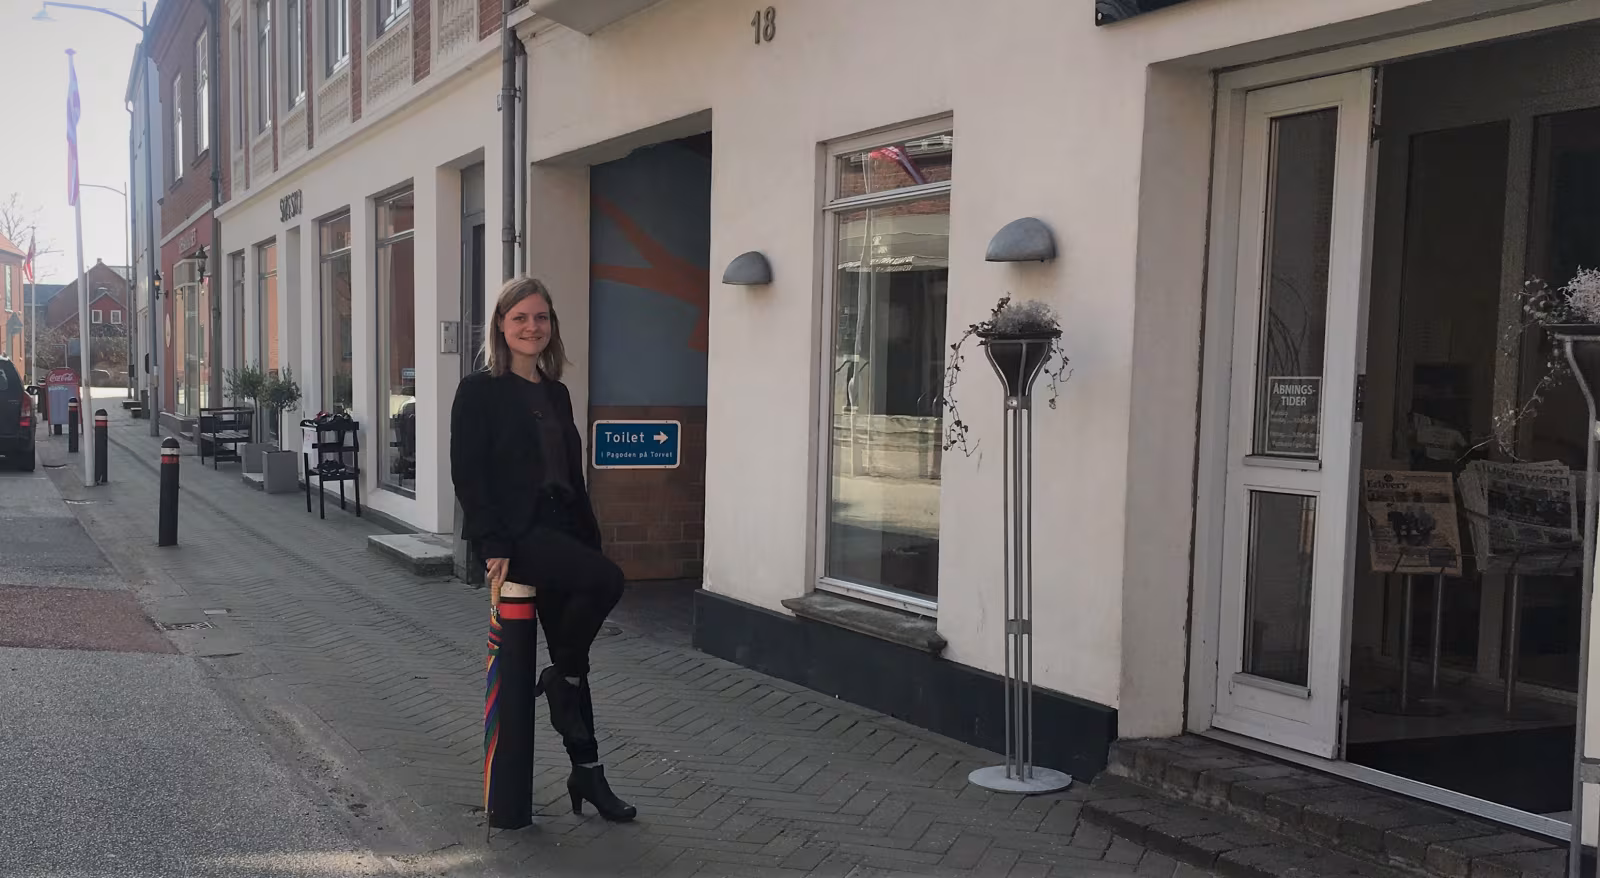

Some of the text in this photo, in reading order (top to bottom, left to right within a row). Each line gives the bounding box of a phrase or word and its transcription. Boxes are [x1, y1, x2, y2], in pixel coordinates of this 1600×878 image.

[751, 5, 776, 44] 18
[1273, 382, 1316, 395] ÅBNINGS-
[1281, 396, 1307, 406] TIDER
[605, 432, 644, 443] Toilet
[639, 451, 648, 459] på
